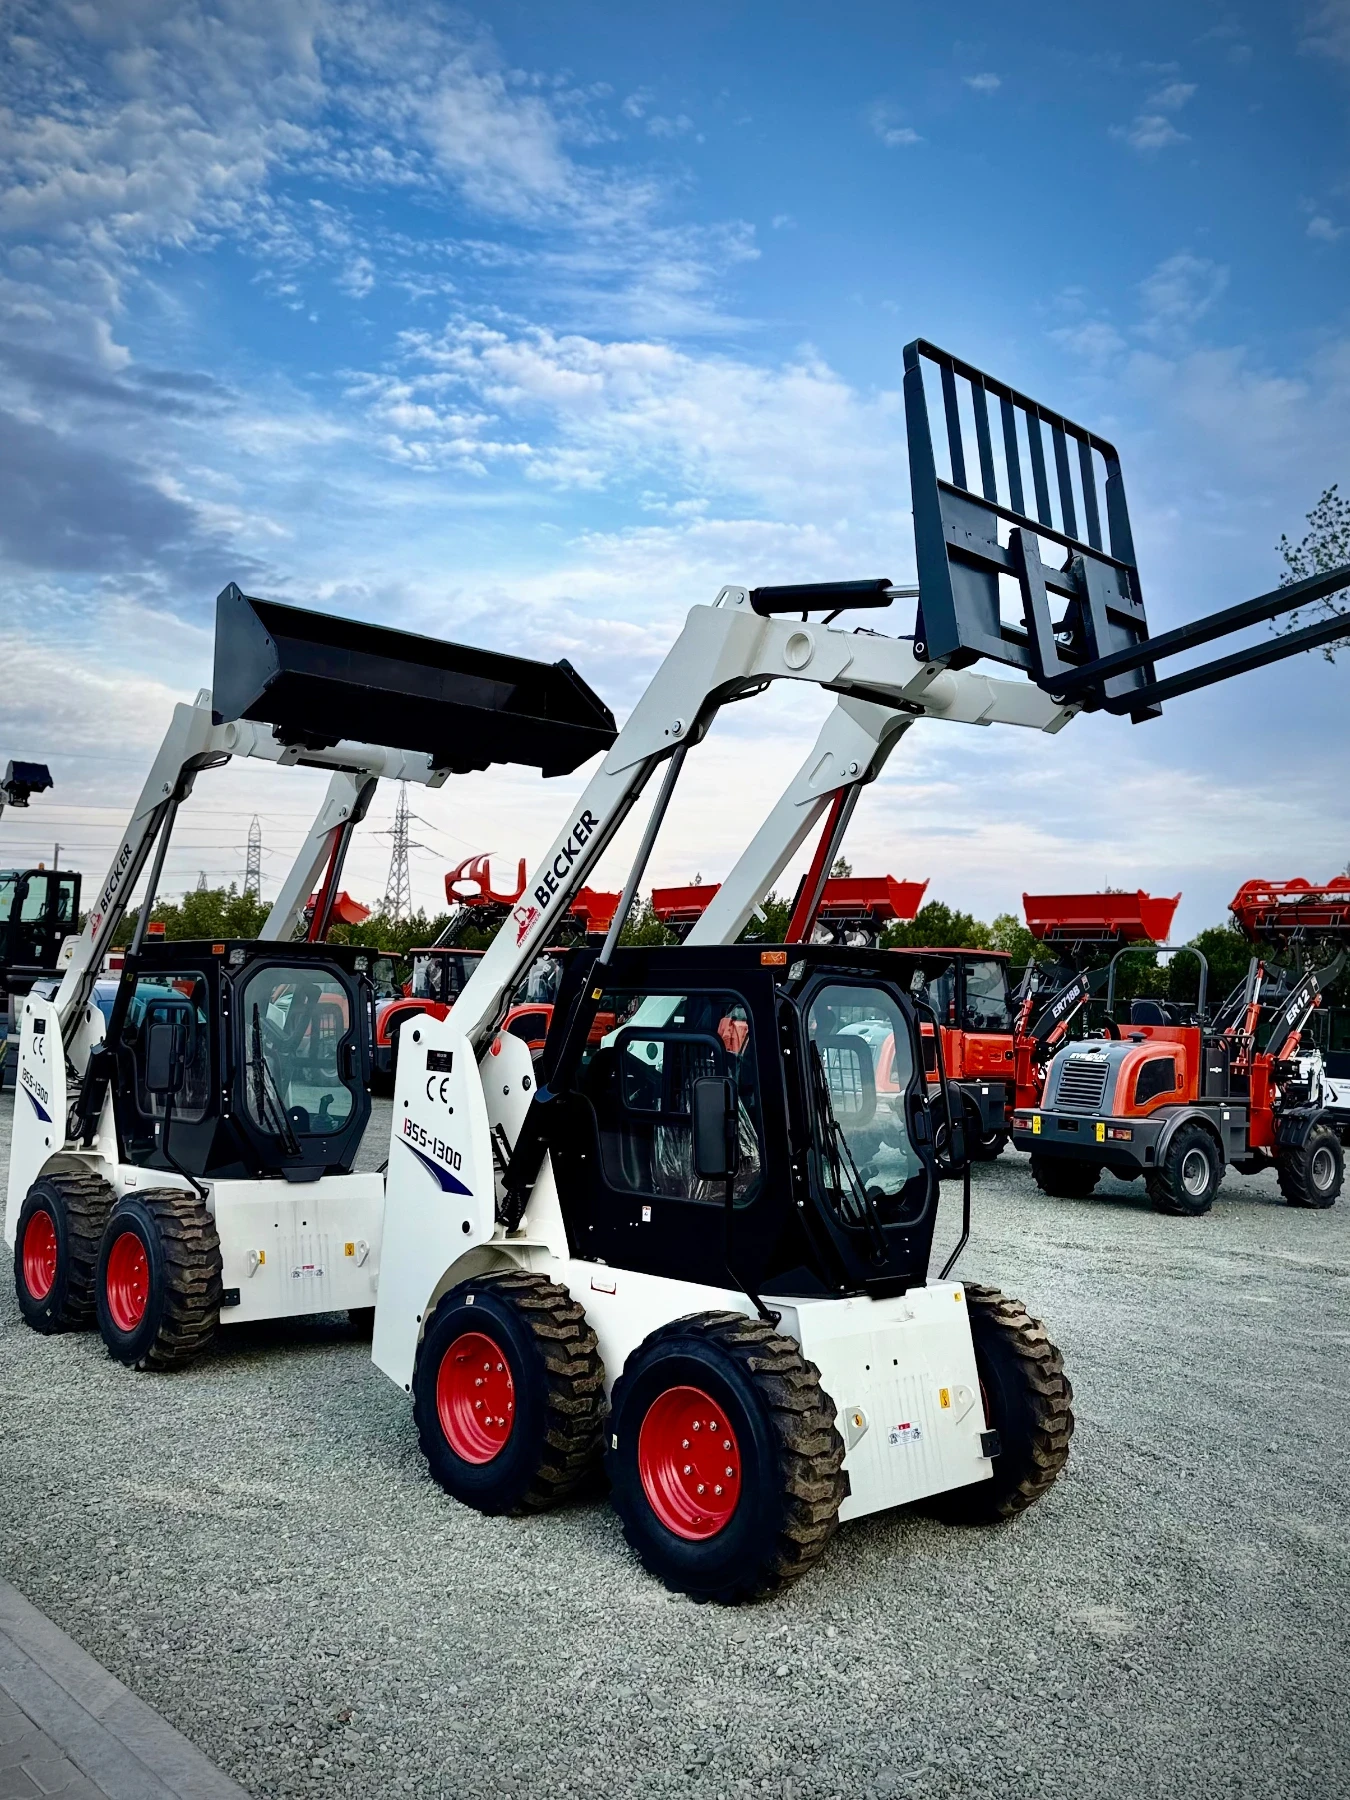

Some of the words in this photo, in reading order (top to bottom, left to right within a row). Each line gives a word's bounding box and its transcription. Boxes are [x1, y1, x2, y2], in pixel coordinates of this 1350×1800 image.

[534, 809, 600, 909] BECKER
[100, 843, 133, 915] BECKER
[1051, 984, 1081, 1019] ER718B
[1285, 988, 1311, 1026] ER12
[32, 1036, 44, 1056] CE
[426, 1075, 450, 1104] CE
[403, 1117, 462, 1171] BSS-1300
